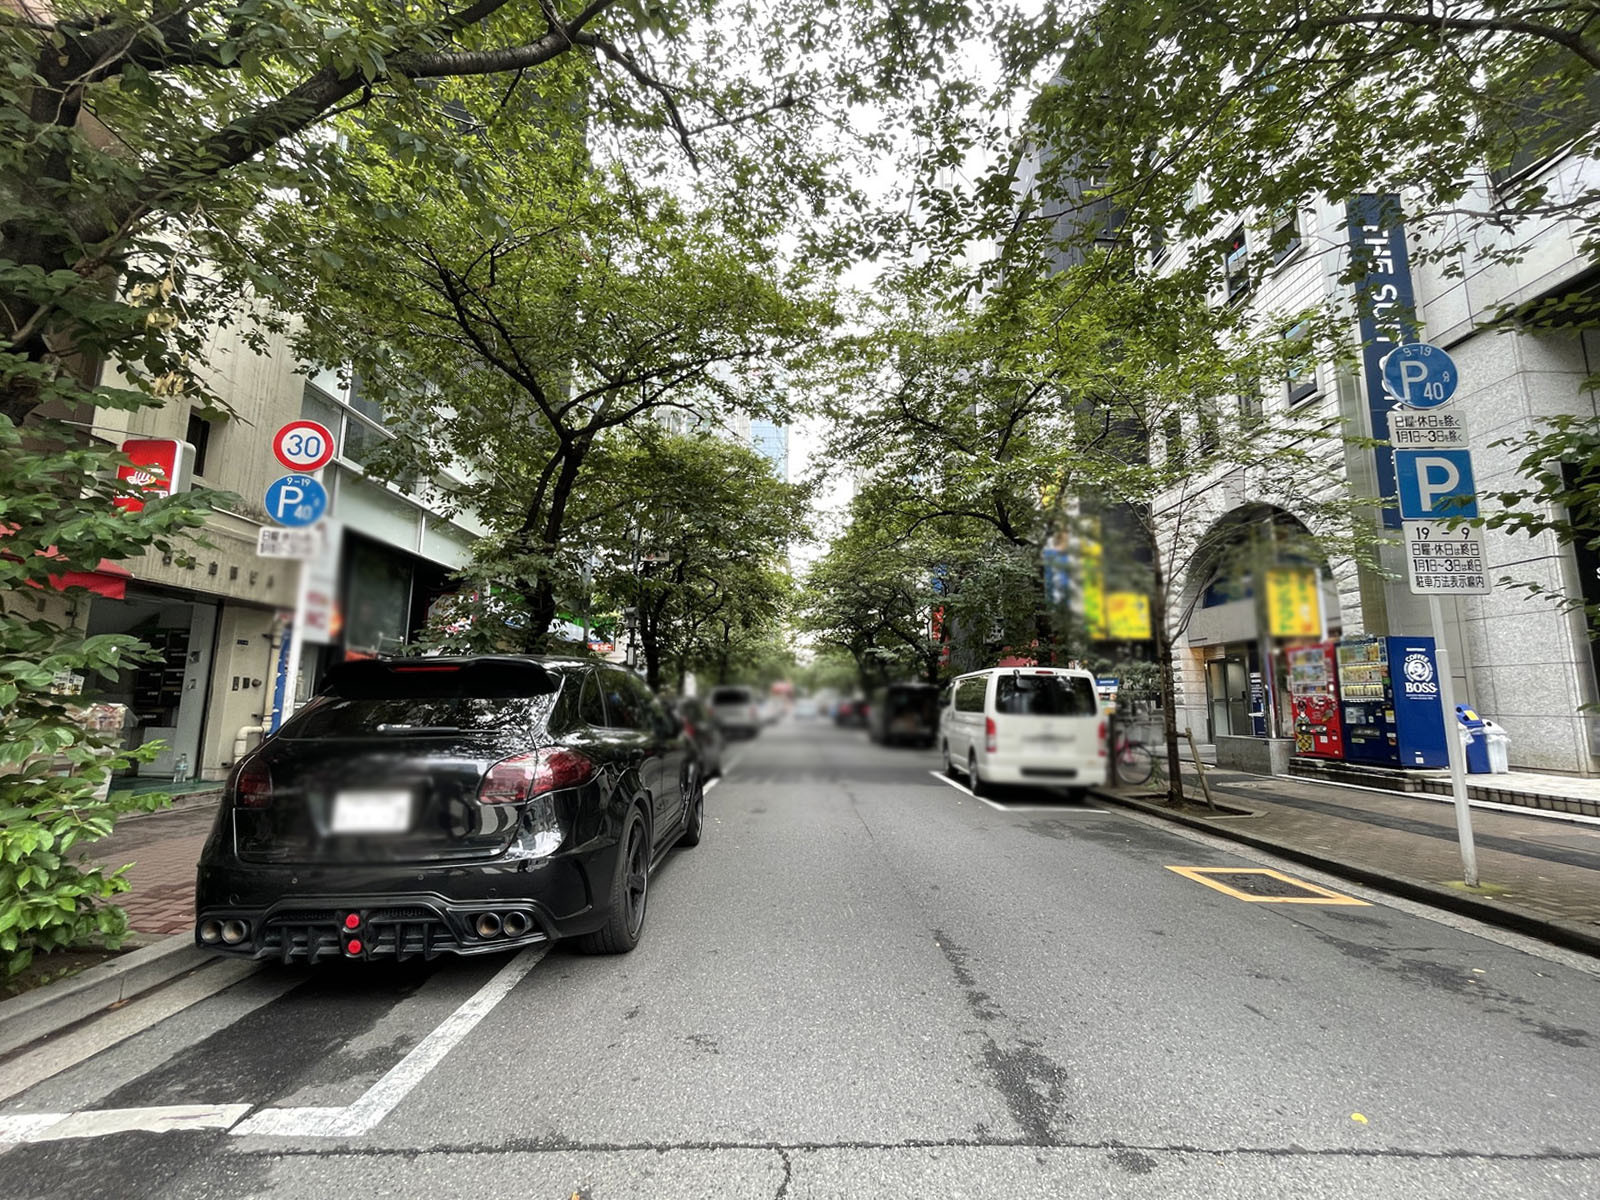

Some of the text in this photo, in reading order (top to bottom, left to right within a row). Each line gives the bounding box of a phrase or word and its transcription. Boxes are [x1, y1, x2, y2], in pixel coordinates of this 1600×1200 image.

[1402, 345, 1432, 357] 9-19
[1400, 361, 1428, 401] P
[1423, 382, 1444, 401] 40
[287, 434, 321, 458] 30
[286, 476, 311, 487] 9-19
[1415, 456, 1460, 512] P
[277, 485, 304, 518] P
[294, 504, 313, 519] 40
[1416, 527, 1430, 540] 19
[1461, 527, 1470, 540] 9
[1404, 682, 1438, 694] BOSS
